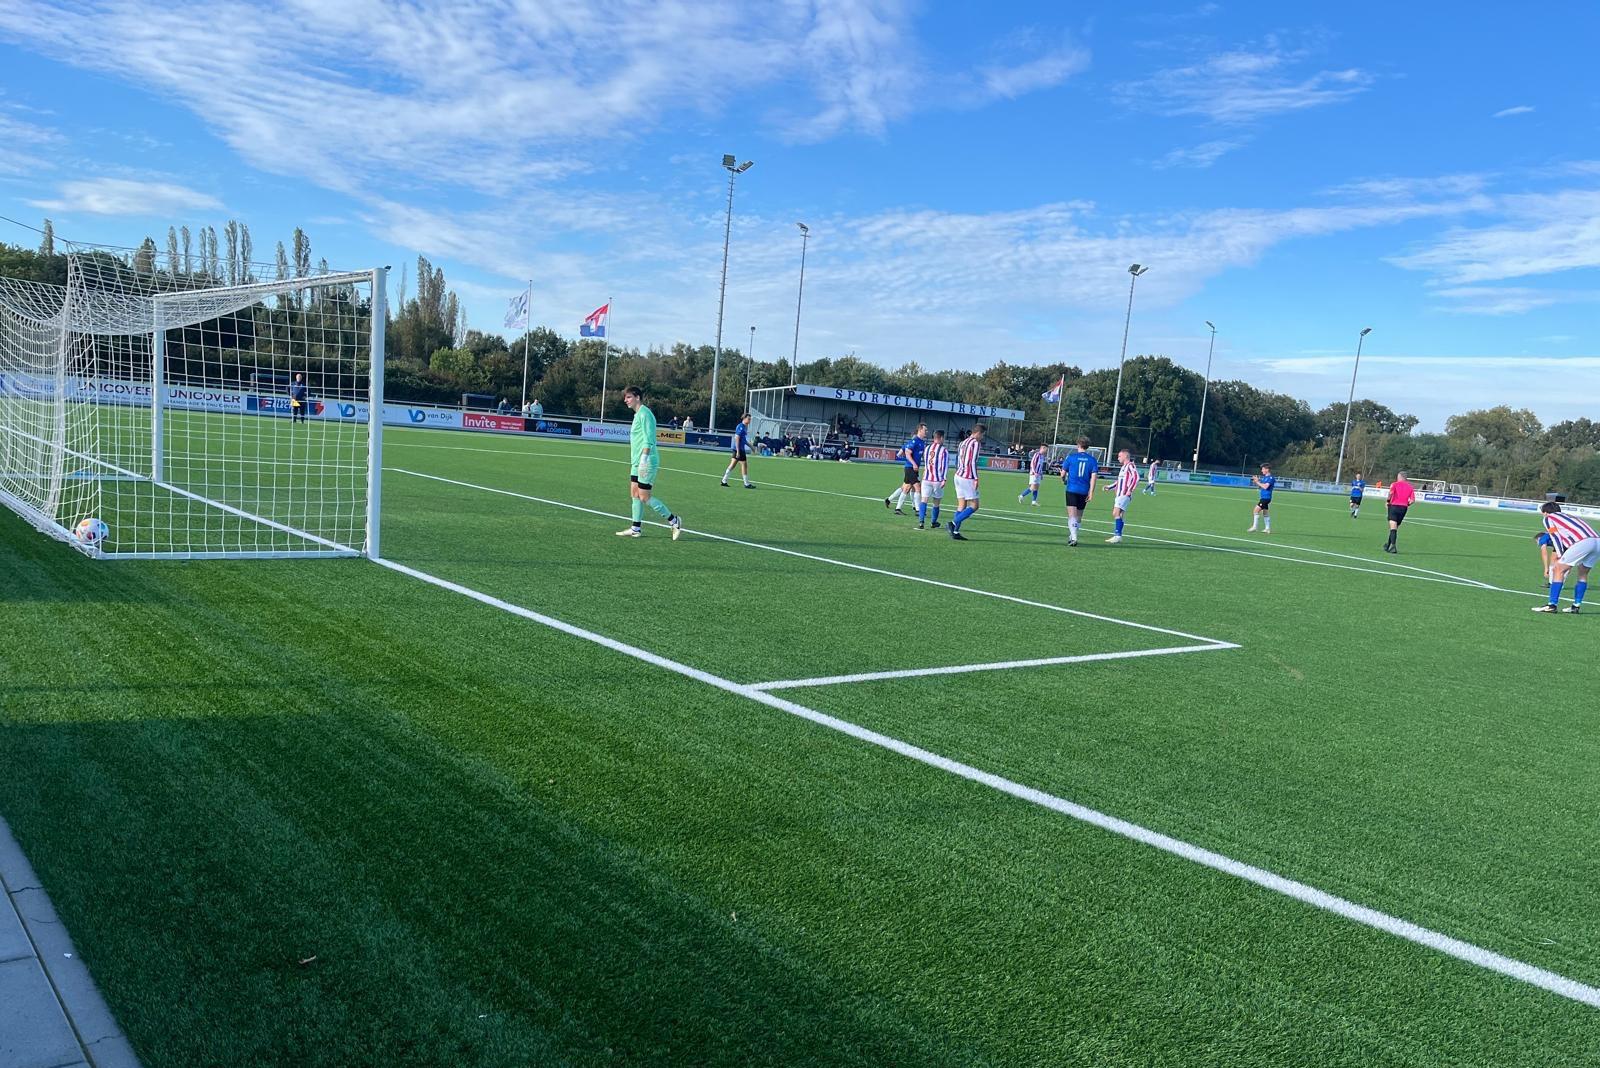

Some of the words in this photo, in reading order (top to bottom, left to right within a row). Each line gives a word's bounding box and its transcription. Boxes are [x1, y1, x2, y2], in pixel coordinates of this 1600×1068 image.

[169, 389, 241, 404] UNICOVER
[835, 389, 933, 409] SPORTCLUB
[950, 402, 997, 417] IRENE
[440, 413, 453, 421] Dijk
[863, 450, 880, 460] ING
[990, 460, 1006, 469] ING
[1078, 461, 1086, 478] 11
